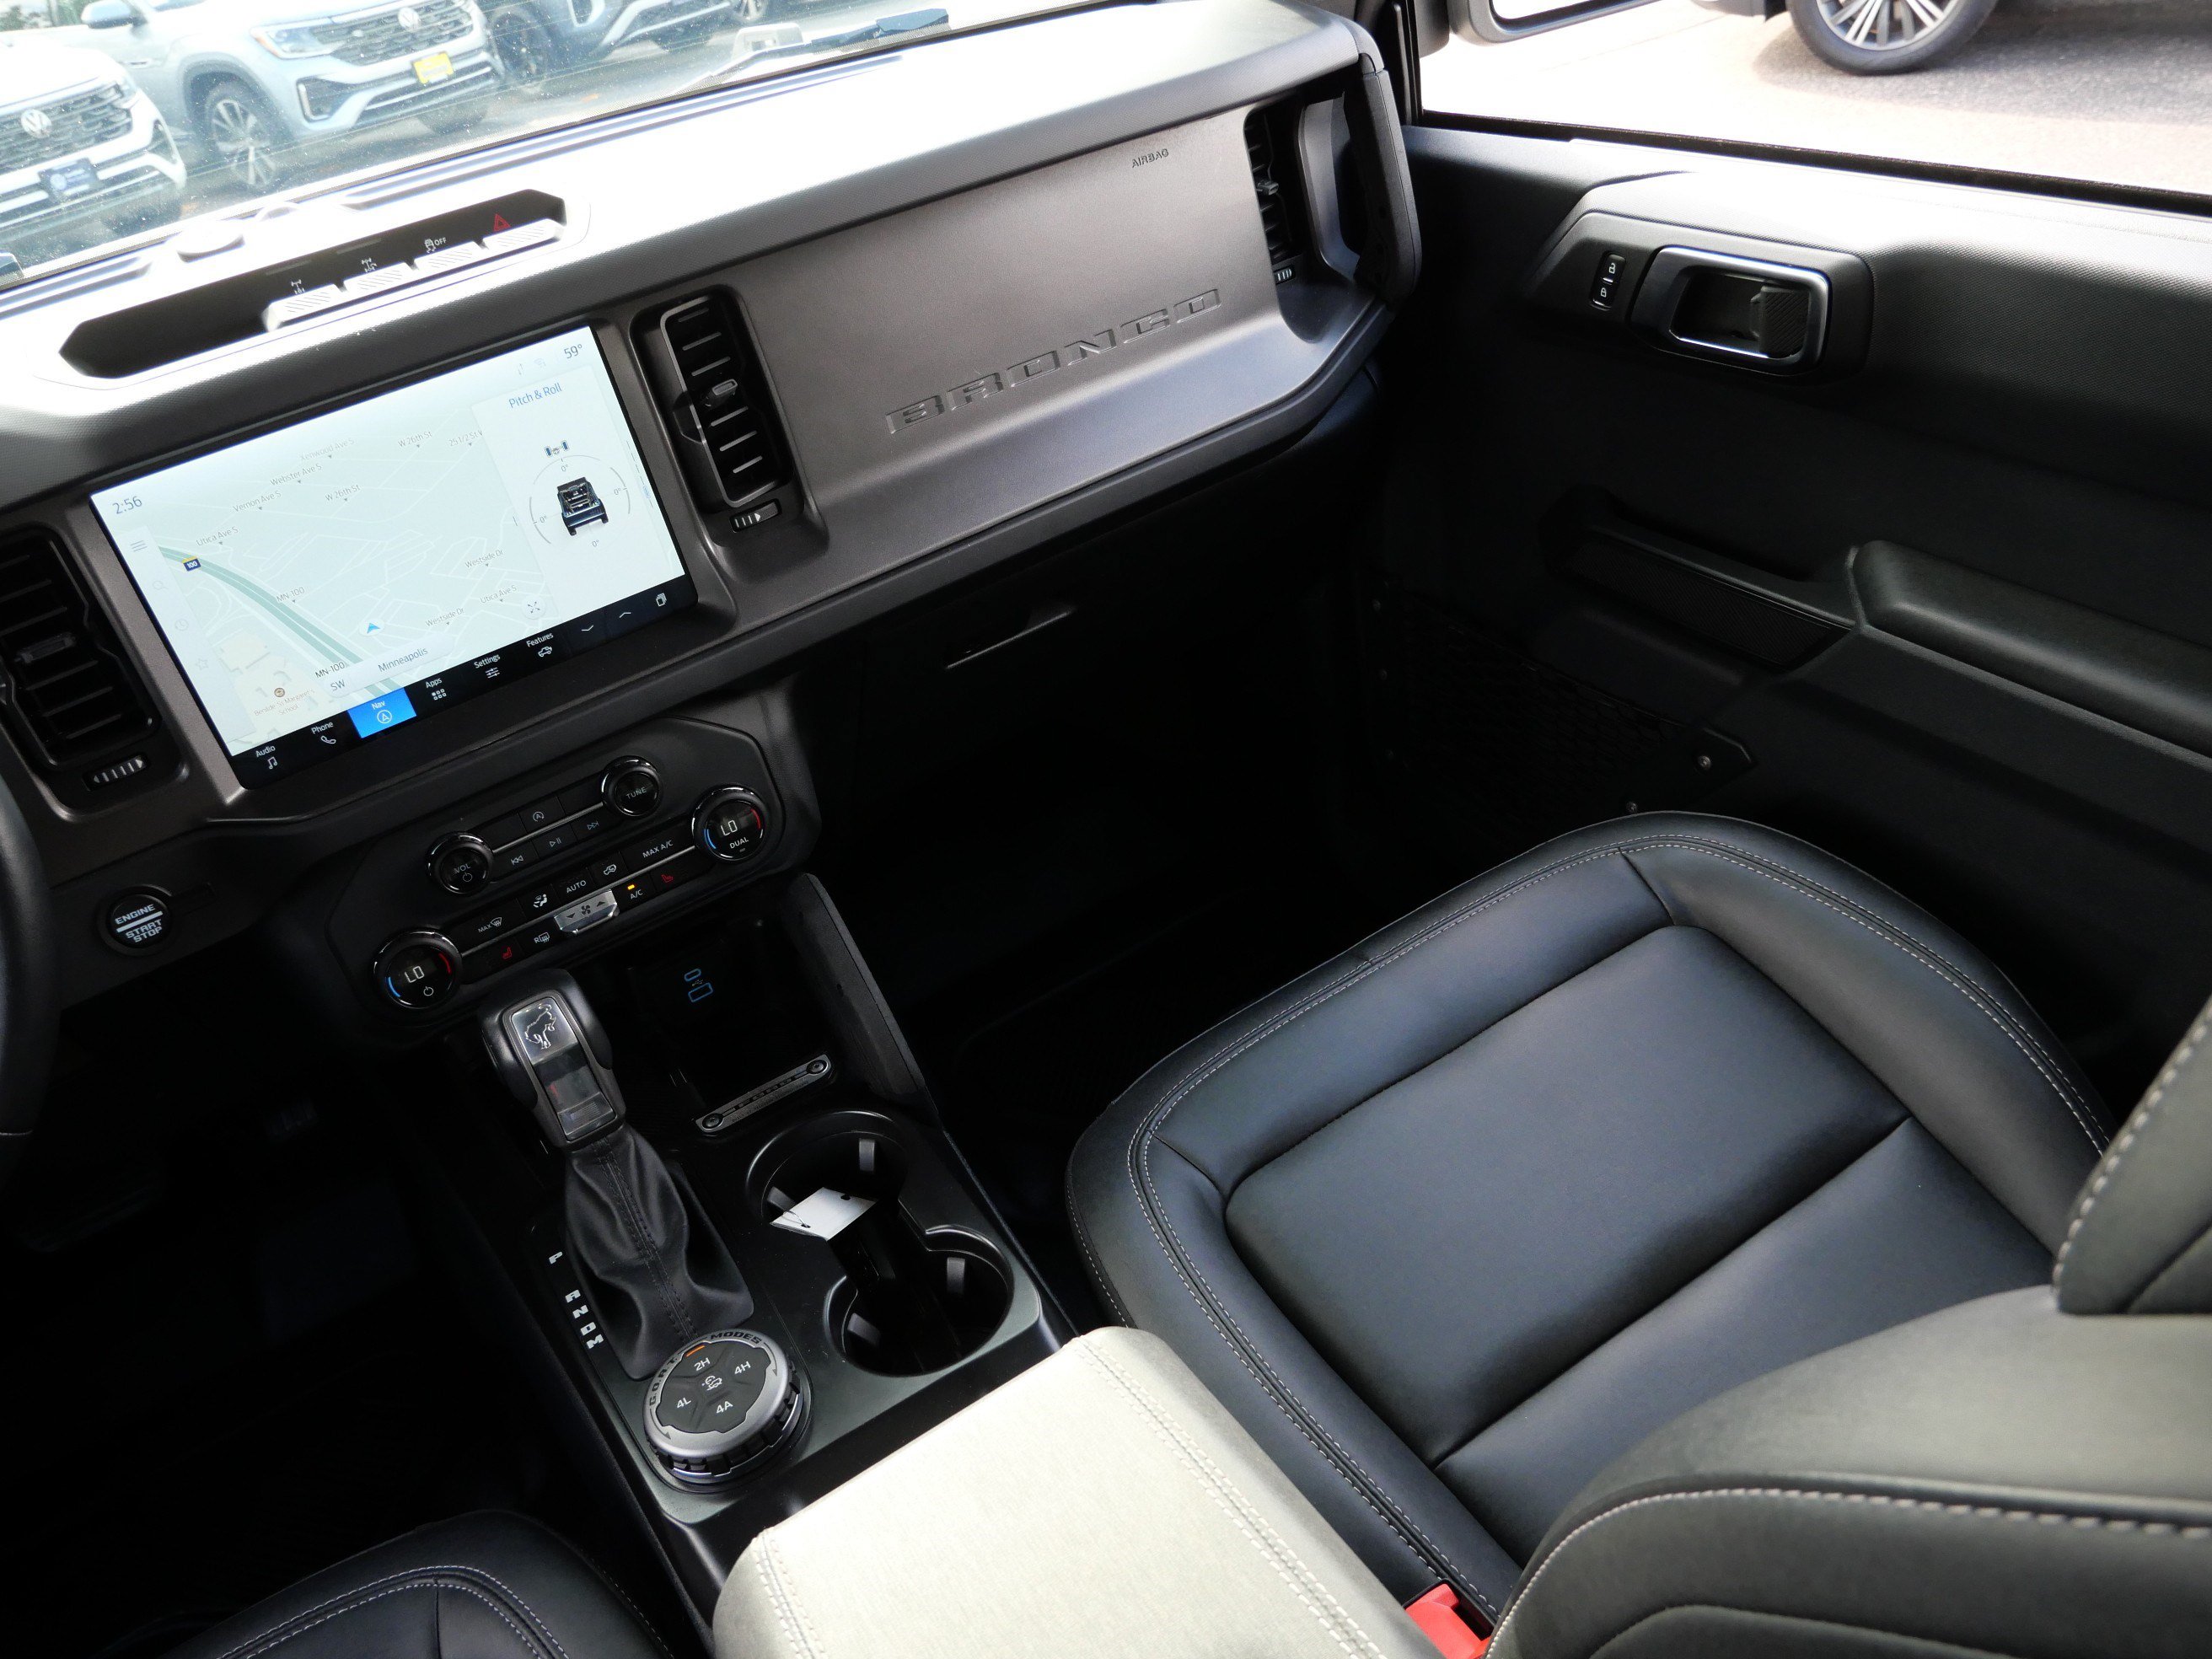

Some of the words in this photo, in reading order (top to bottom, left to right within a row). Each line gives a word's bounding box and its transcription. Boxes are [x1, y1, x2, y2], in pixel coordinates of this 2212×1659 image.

[1131, 148, 1169, 168] AIRBAG
[434, 237, 447, 246] OFF
[564, 343, 583, 359] 59°
[885, 288, 1221, 434] BRONCO
[508, 393, 533, 408] Pitch
[534, 389, 543, 400] &
[542, 382, 562, 396] Roll
[406, 433, 423, 445] 26th
[270, 472, 301, 486] Webster
[301, 467, 315, 476] Ave
[351, 484, 361, 492] St
[112, 496, 142, 514] 2:56
[233, 498, 260, 513] Vernon
[260, 493, 274, 503] Ave
[196, 535, 217, 546] Utica
[217, 529, 232, 540] Ave
[186, 561, 198, 569] 100
[465, 554, 495, 569] Westside
[495, 550, 503, 558] Dr
[276, 587, 305, 603] MN-100
[480, 593, 498, 604] Utica
[498, 588, 511, 598] Ave
[425, 613, 452, 627] Westside
[451, 608, 464, 617] Dr
[526, 632, 554, 647] Features
[378, 647, 428, 673] Minneapolis
[474, 653, 501, 668] Settings
[315, 662, 346, 679] MN-100
[330, 679, 346, 691] SW
[425, 677, 442, 689] Apps
[371, 700, 385, 710] Nav
[311, 721, 334, 735] Phone
[255, 745, 276, 758] Audio
[625, 787, 647, 800] TUNE
[720, 819, 738, 836] LO
[642, 846, 660, 858] MAX
[660, 840, 674, 851] A/C
[729, 836, 749, 850] DUAL
[454, 862, 470, 875] VOL
[566, 879, 587, 894] AUTO
[630, 889, 643, 900] A/C
[115, 904, 156, 925] ENGINE
[125, 918, 163, 939] START
[132, 926, 163, 943] STOP
[478, 924, 491, 933] MAX
[404, 965, 425, 984] LO
[549, 1251, 563, 1264] P
[572, 1304, 588, 1319] N
[586, 1334, 604, 1350] M
[710, 1330, 762, 1345] MODES
[694, 1357, 711, 1372] 2H
[733, 1361, 751, 1375] 4H
[676, 1397, 692, 1409] 4L
[716, 1400, 733, 1415] 4A
